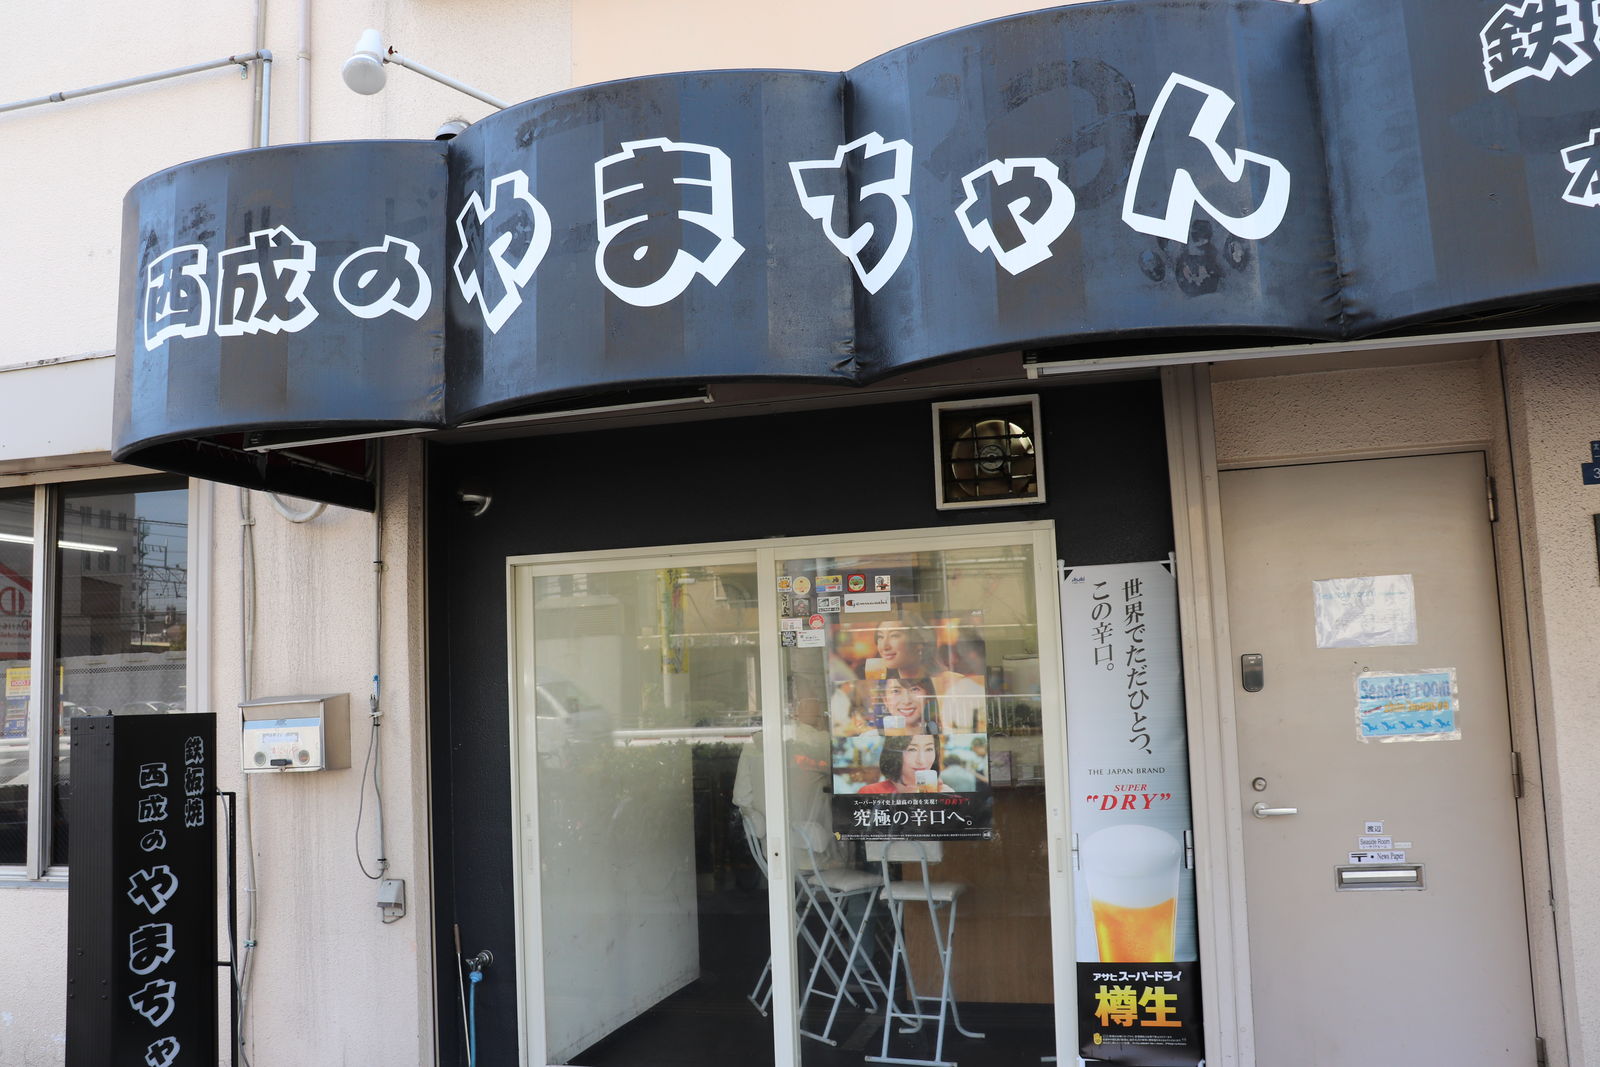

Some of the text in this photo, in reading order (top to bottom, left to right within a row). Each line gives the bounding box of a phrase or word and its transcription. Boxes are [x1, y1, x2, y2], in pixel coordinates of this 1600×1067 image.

[1479, 0, 1600, 93] 鉄
[1090, 580, 1115, 671] この辛口。
[1121, 577, 1153, 755] 世界でただひとつ、
[184, 736, 204, 828] 鉄板焼
[1114, 784, 1147, 792] SUPER
[853, 808, 973, 827] 究極の辛口へ。
[1092, 970, 1182, 981] アサヒスーパードライ
[1094, 985, 1182, 1027] 樽生
